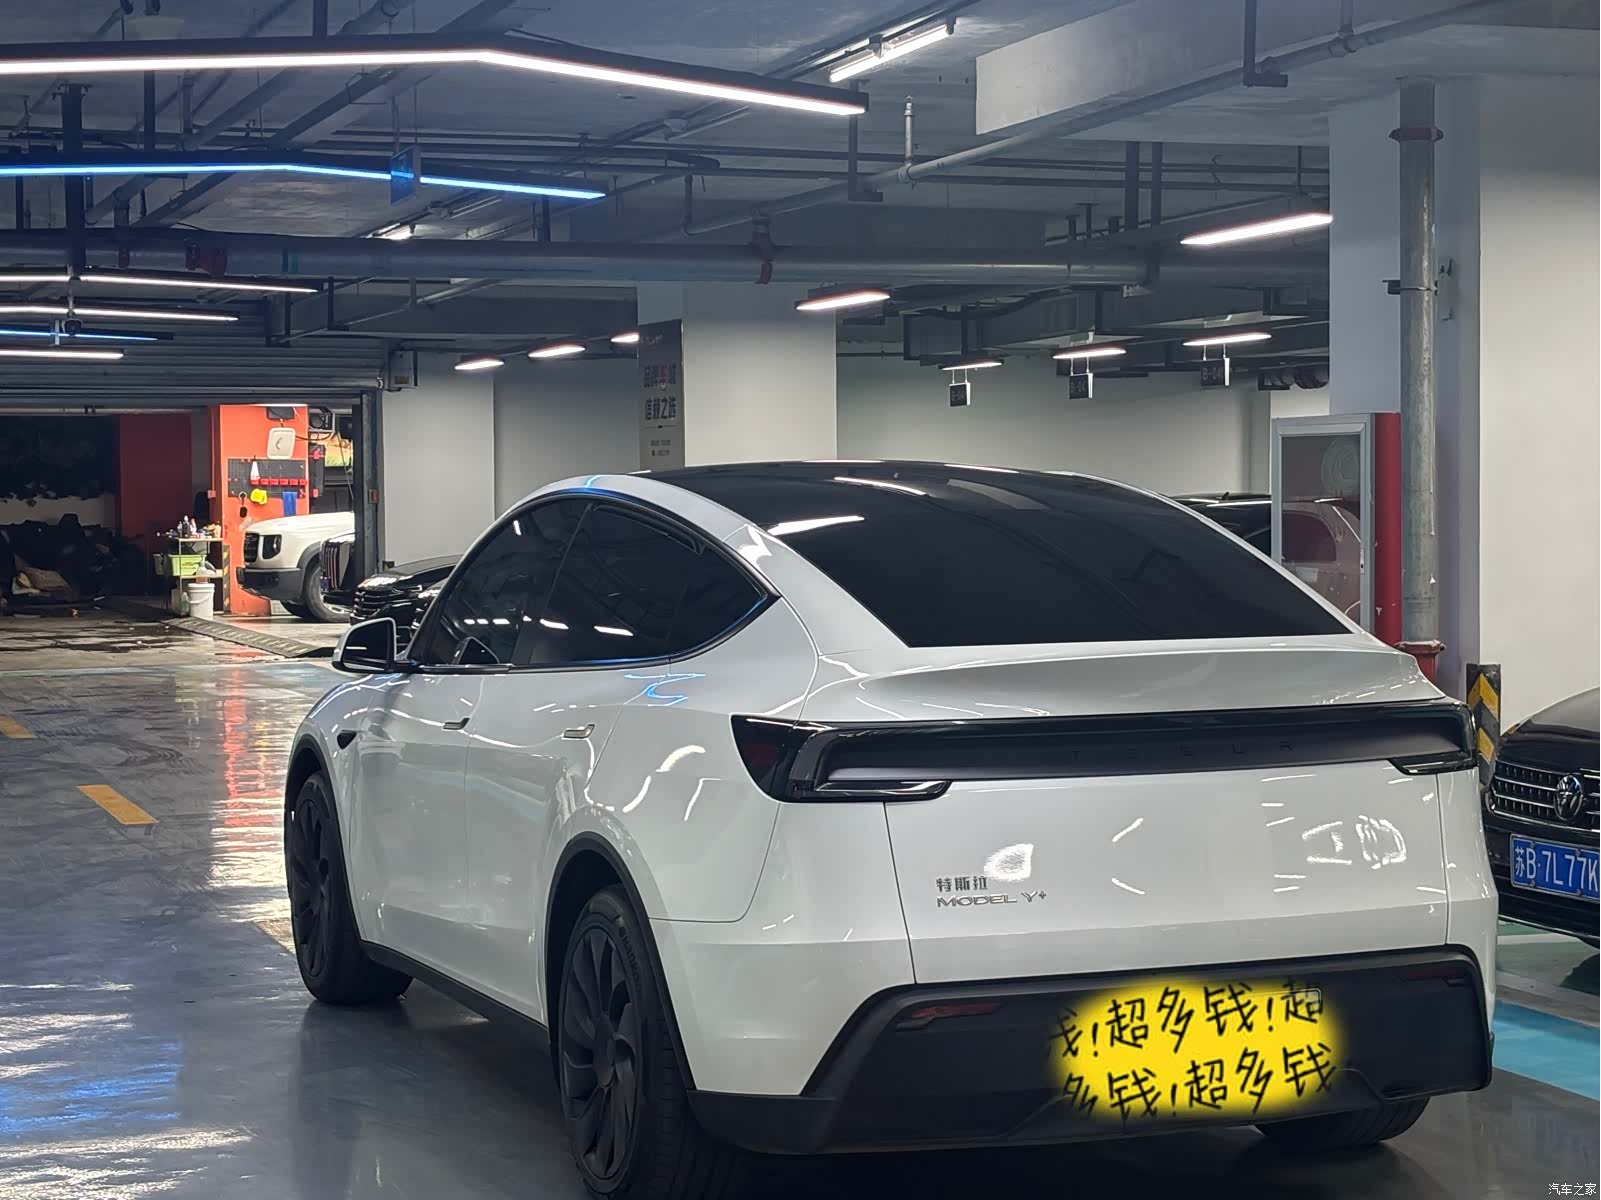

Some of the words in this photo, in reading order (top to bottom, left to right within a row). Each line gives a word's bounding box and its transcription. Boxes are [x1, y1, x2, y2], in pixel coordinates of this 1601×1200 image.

[936, 876, 988, 892] 特斯拉
[936, 893, 1018, 908] MODEL
